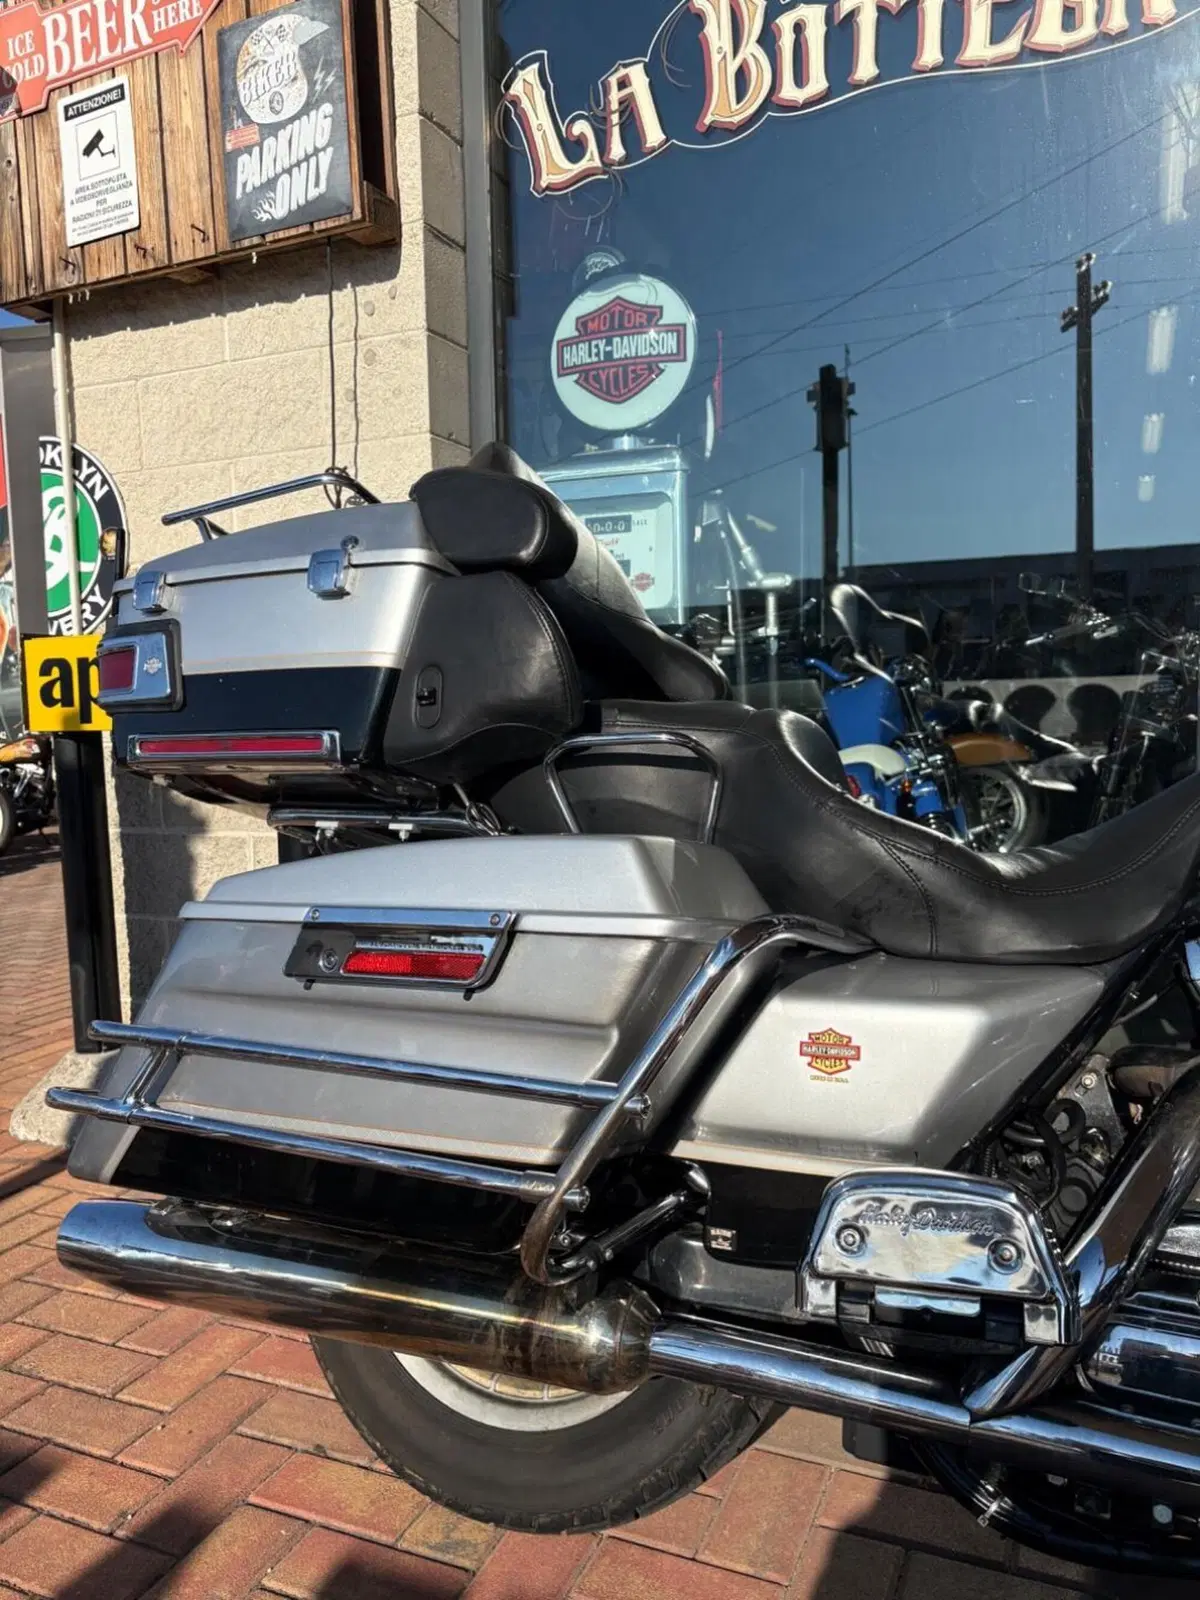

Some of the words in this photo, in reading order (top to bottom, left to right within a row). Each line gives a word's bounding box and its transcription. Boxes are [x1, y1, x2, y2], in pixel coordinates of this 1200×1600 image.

[152, 0, 203, 33] HERE
[7, 30, 35, 60] ICE
[41, 0, 153, 81] BEER
[239, 50, 297, 106] BIKER
[67, 88, 122, 117] ATTENZIONE!
[504, 62, 667, 193] LA
[236, 102, 334, 199] PARKING
[75, 184, 90, 195] AREA
[90, 172, 127, 190] SOTTOPOSTA
[275, 147, 334, 219] ONLY
[72, 211, 95, 223] RAGIONI
[102, 200, 133, 215] SICUREZZA
[96, 197, 107, 207] PER
[588, 304, 648, 334] MOTOR
[563, 331, 677, 368] HARLEY-DAVIDSON
[588, 364, 650, 396] CYCLES
[814, 1033, 846, 1043] MOTOR
[814, 1056, 844, 1069] CYCLES
